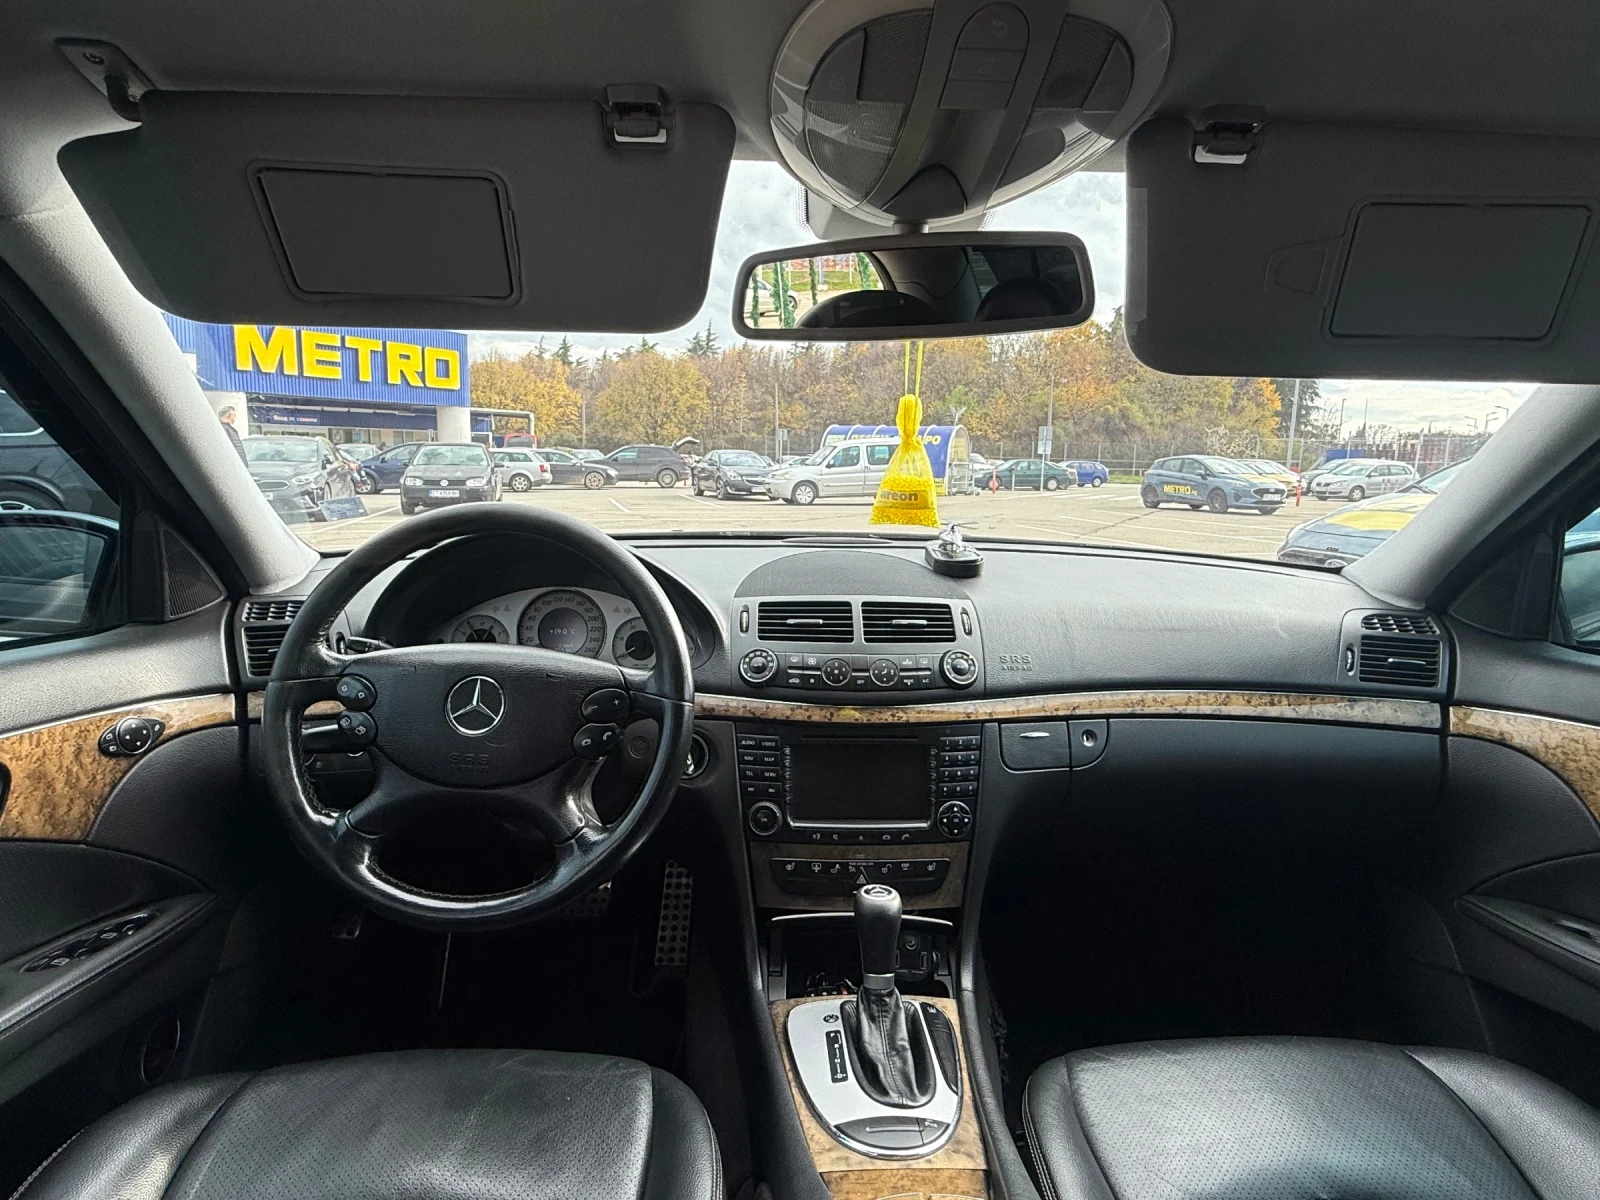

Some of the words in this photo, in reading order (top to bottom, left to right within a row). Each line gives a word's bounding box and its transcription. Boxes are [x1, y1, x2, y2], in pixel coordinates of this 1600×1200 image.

[233, 324, 460, 391] METRO
[880, 490, 918, 501] areon
[1000, 654, 1031, 664] SRS
